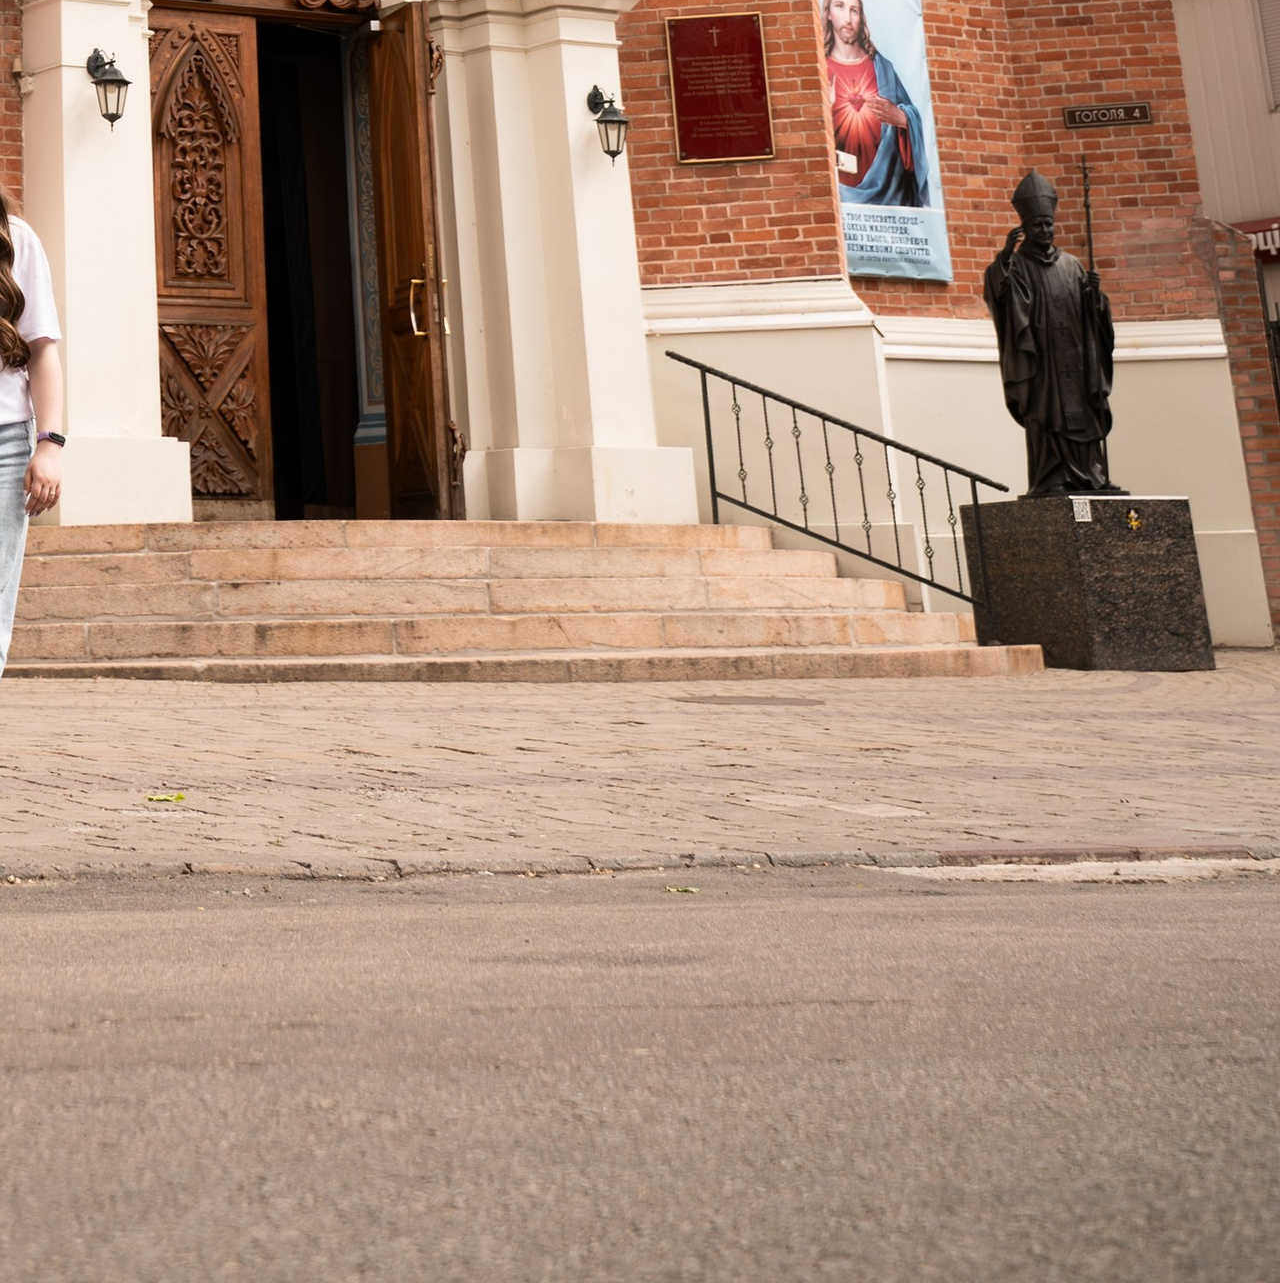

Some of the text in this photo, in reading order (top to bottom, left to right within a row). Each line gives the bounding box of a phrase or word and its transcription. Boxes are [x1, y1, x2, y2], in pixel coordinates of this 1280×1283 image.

[1132, 108, 1140, 118] 4
[864, 214, 896, 224] ПРЕСВЯТЕ
[847, 243, 893, 254] БЕЗМЕЖНОМУ
